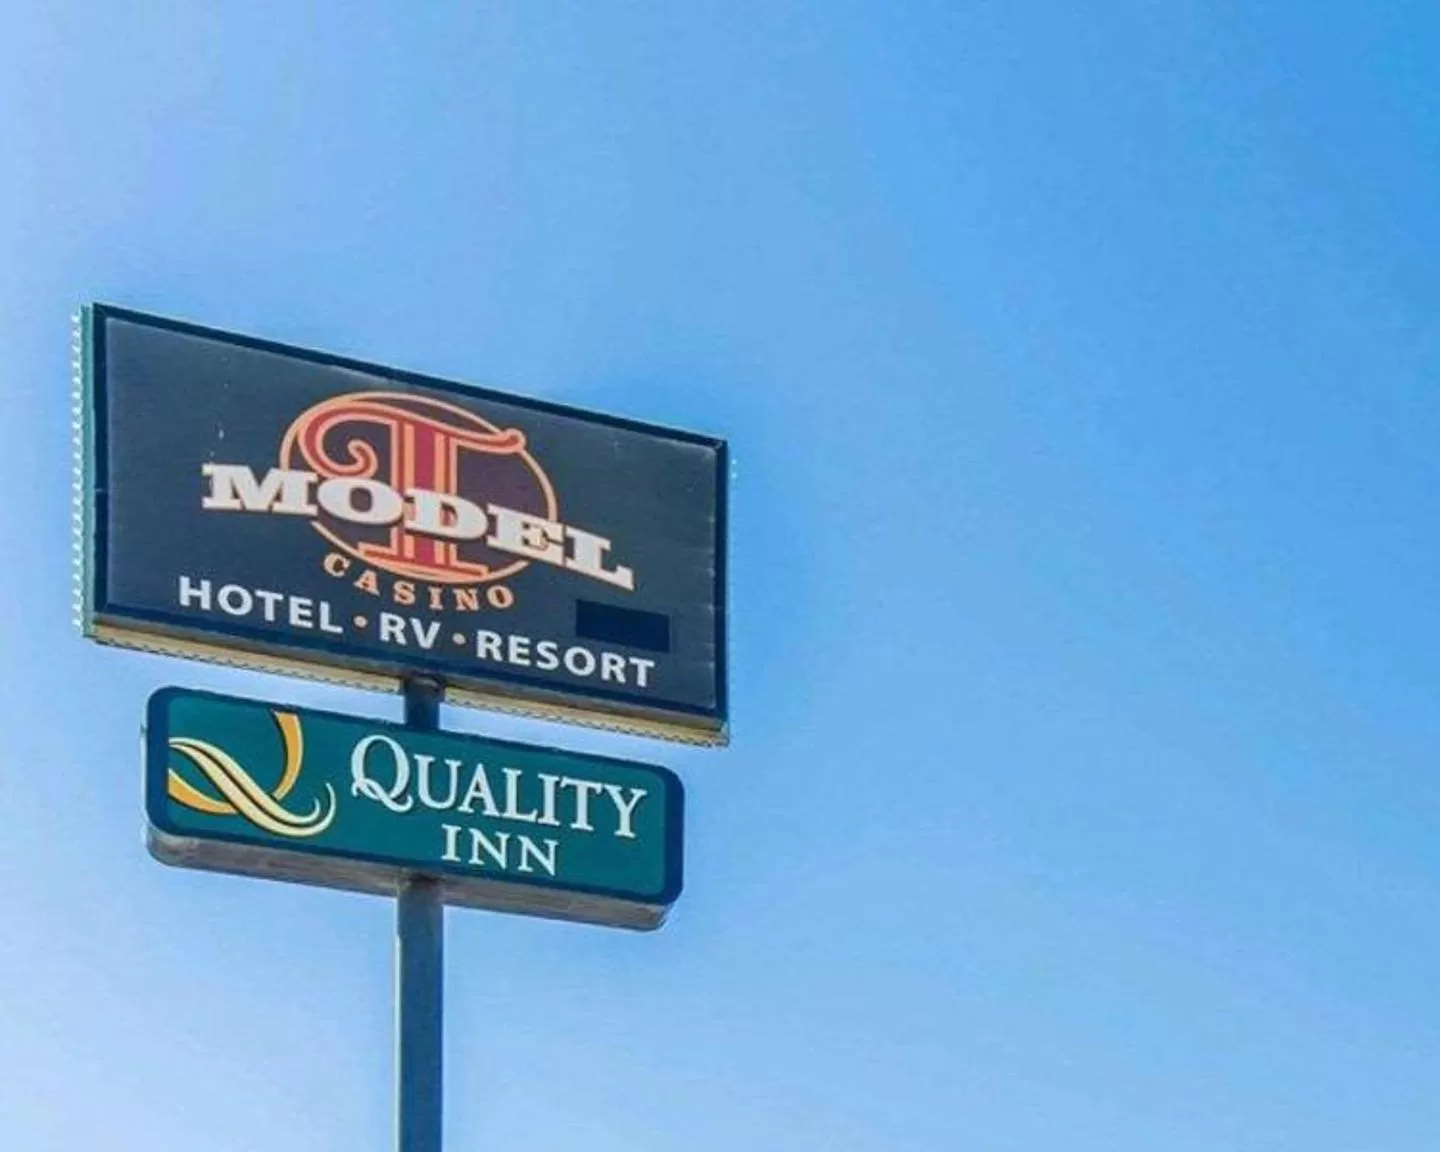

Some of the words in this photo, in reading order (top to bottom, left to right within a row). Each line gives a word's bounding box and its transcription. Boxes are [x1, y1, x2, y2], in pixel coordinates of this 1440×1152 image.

[202, 462, 635, 592] MODEL
[178, 575, 344, 633] HOTEL
[379, 611, 441, 650] RV
[476, 629, 656, 688] RESORT
[323, 551, 515, 612] CASINO
[350, 734, 647, 839] QUALITY
[441, 823, 559, 877] INN
